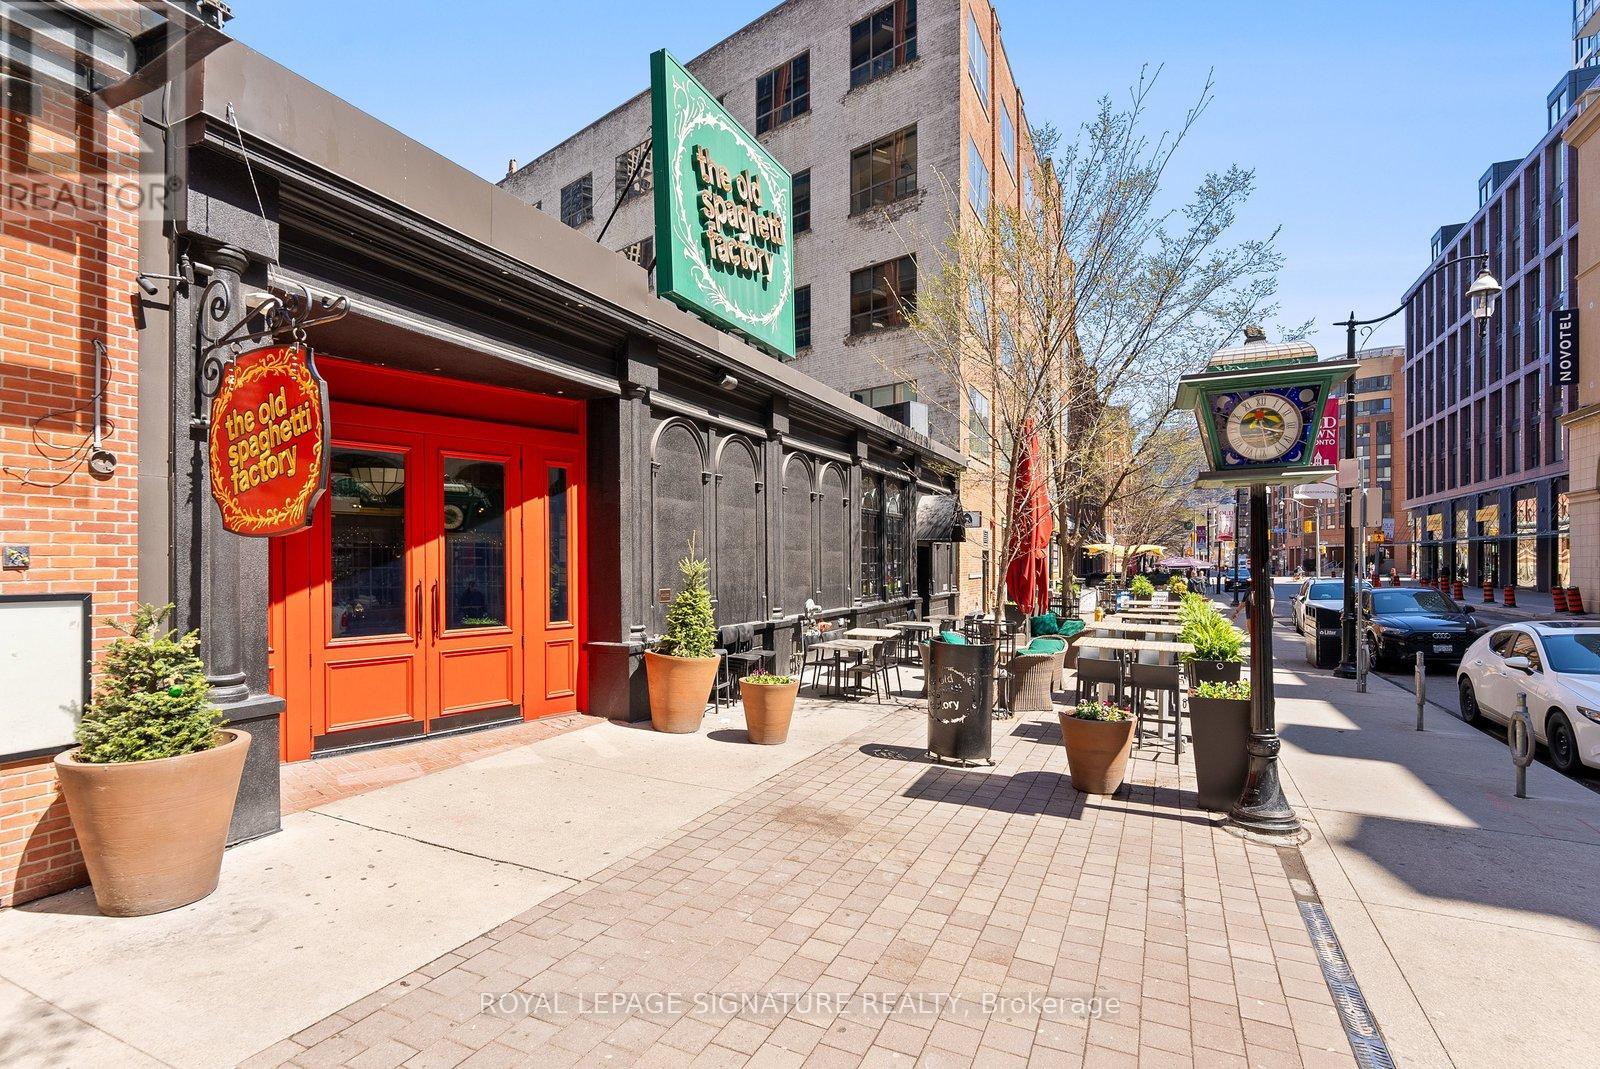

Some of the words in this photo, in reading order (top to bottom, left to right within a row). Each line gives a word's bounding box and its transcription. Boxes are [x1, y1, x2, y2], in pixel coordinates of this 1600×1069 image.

[695, 144, 732, 193] the
[735, 170, 762, 207] old
[702, 190, 785, 246] spaghetti
[707, 222, 774, 283] factory
[1560, 313, 1571, 381] NOVOTEL
[225, 409, 255, 440] the
[259, 386, 287, 424] old
[228, 401, 312, 469] spaghetti
[1317, 429, 1336, 438] WN
[231, 444, 297, 495] factory
